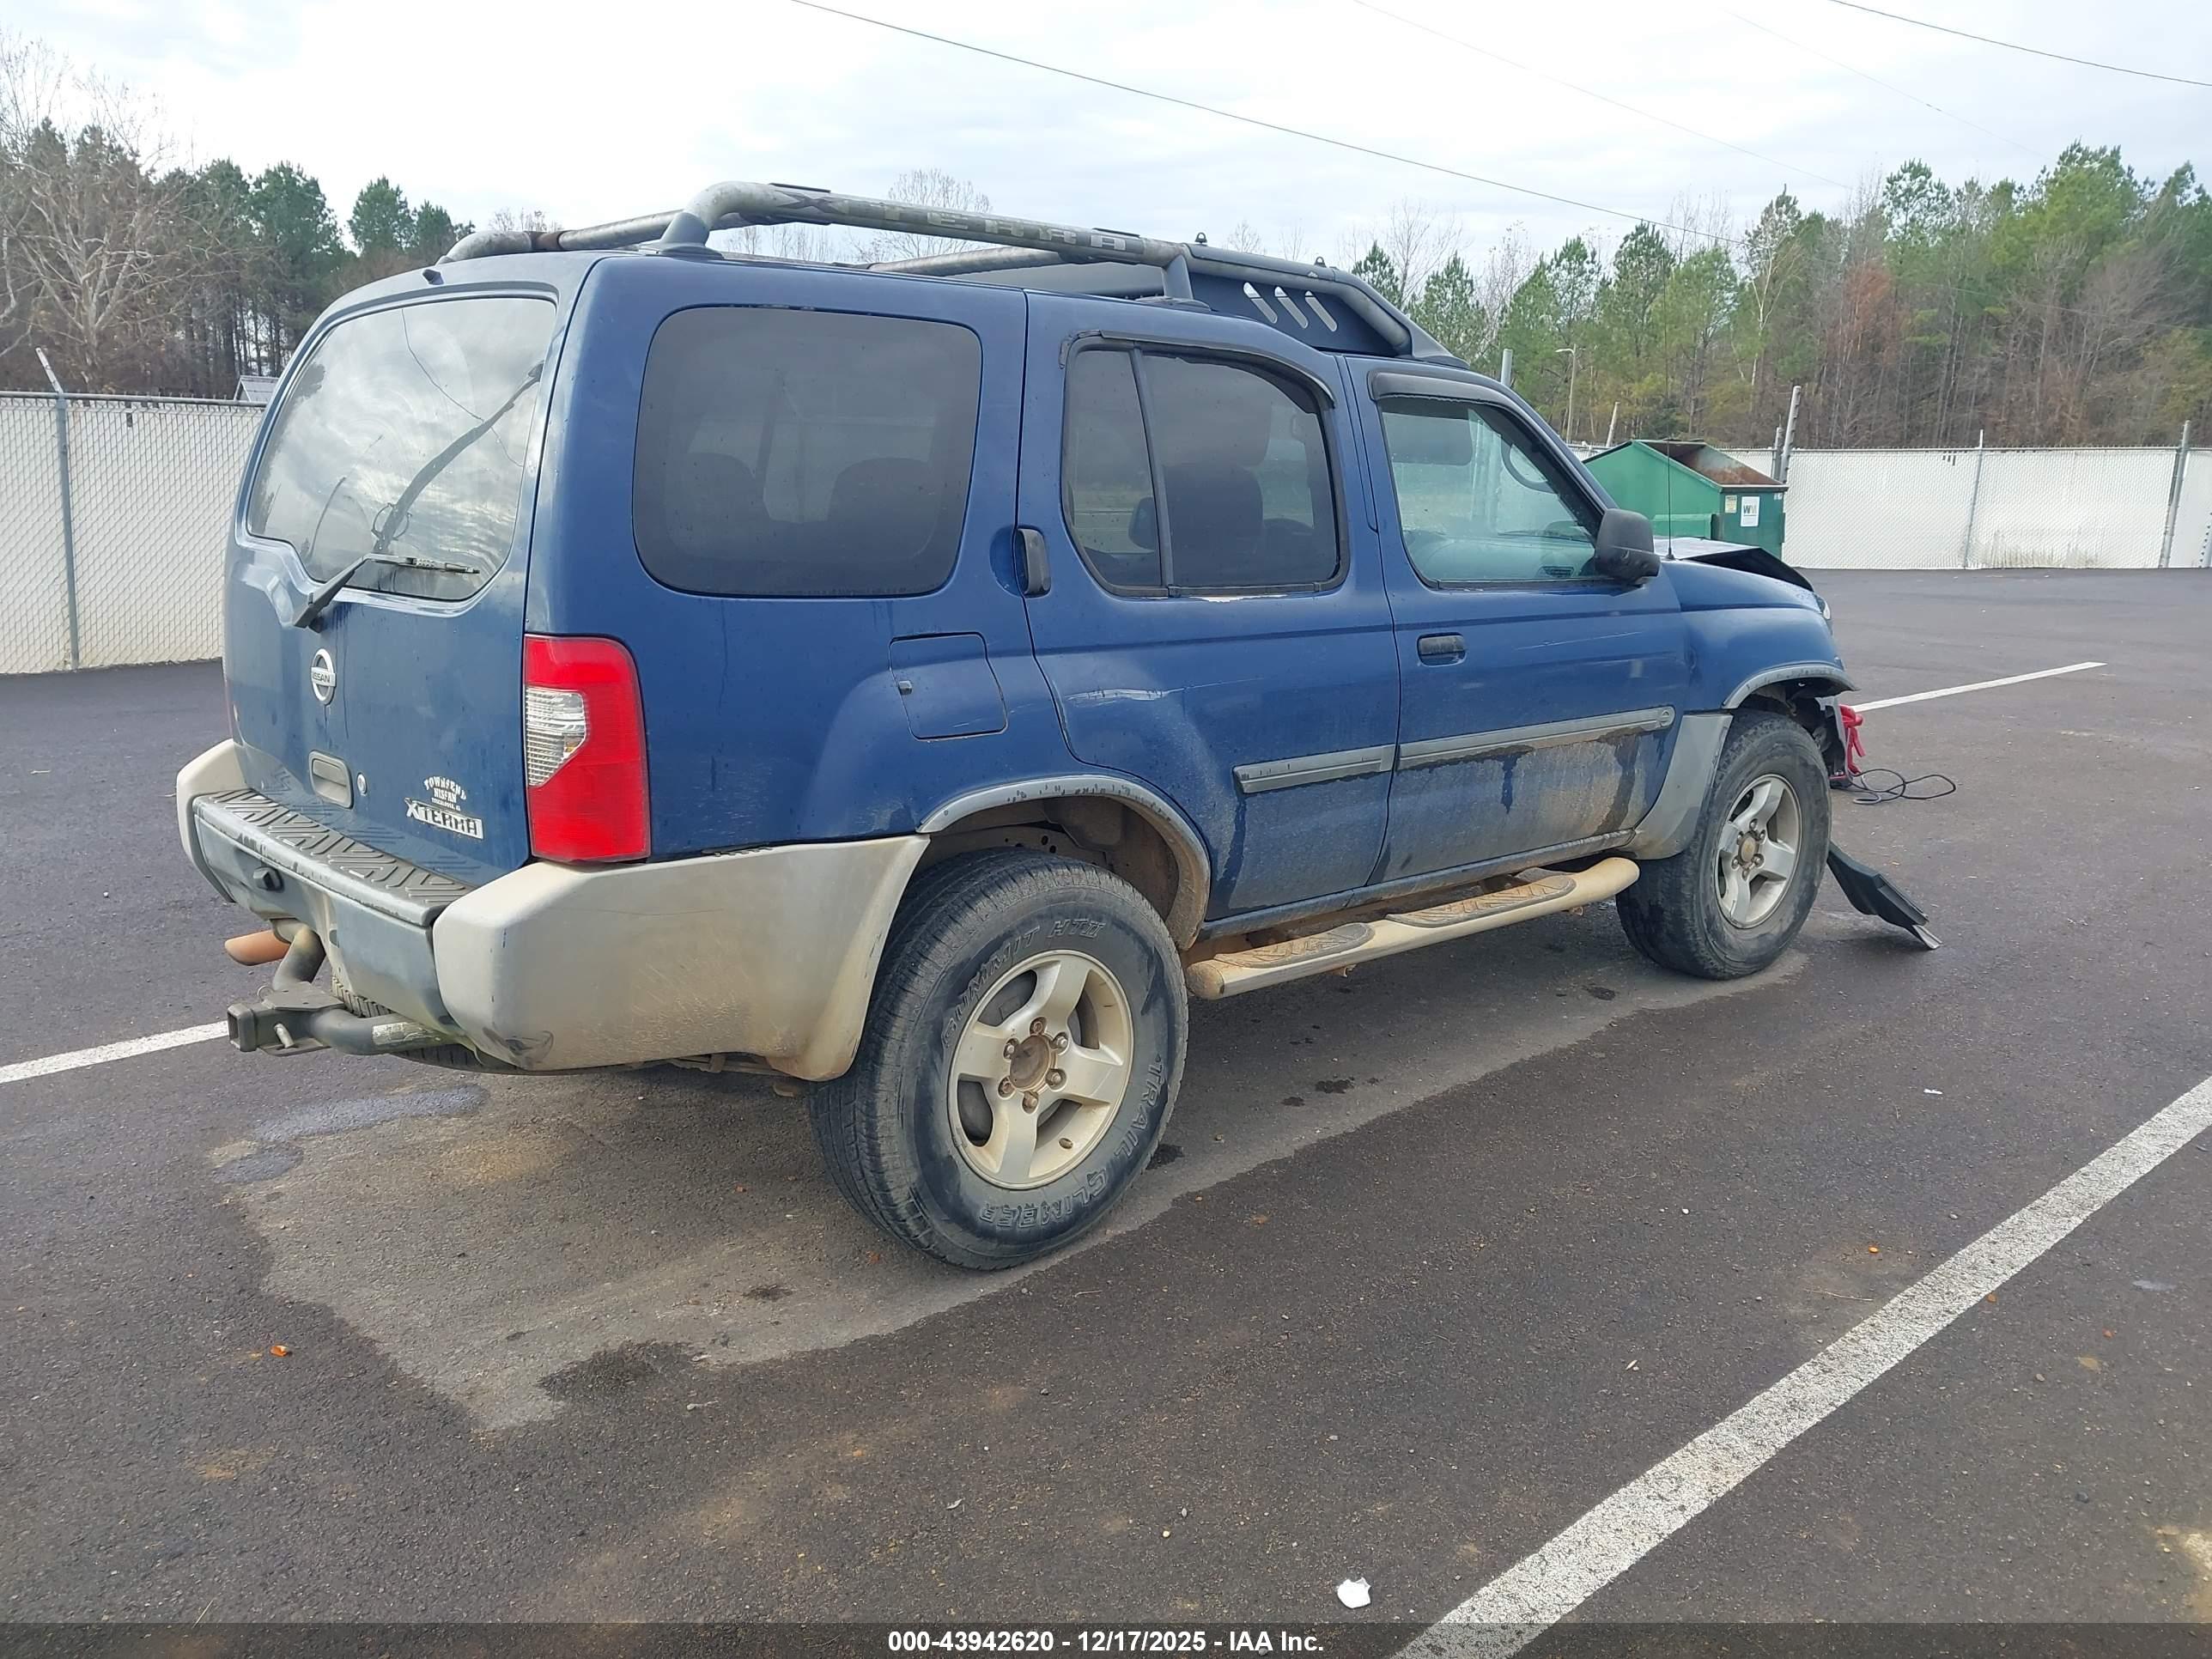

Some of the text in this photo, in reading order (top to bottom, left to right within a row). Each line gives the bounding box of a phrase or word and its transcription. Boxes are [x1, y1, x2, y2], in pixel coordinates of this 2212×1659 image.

[774, 189, 1127, 252] XTERRA
[423, 775, 467, 800] TOWNSEND
[434, 787, 458, 804] NISSAN
[404, 797, 484, 840] XTERRA
[941, 926, 1040, 1048] SUMMIT
[979, 1062, 1166, 1229] TRAIL CLIMBER
